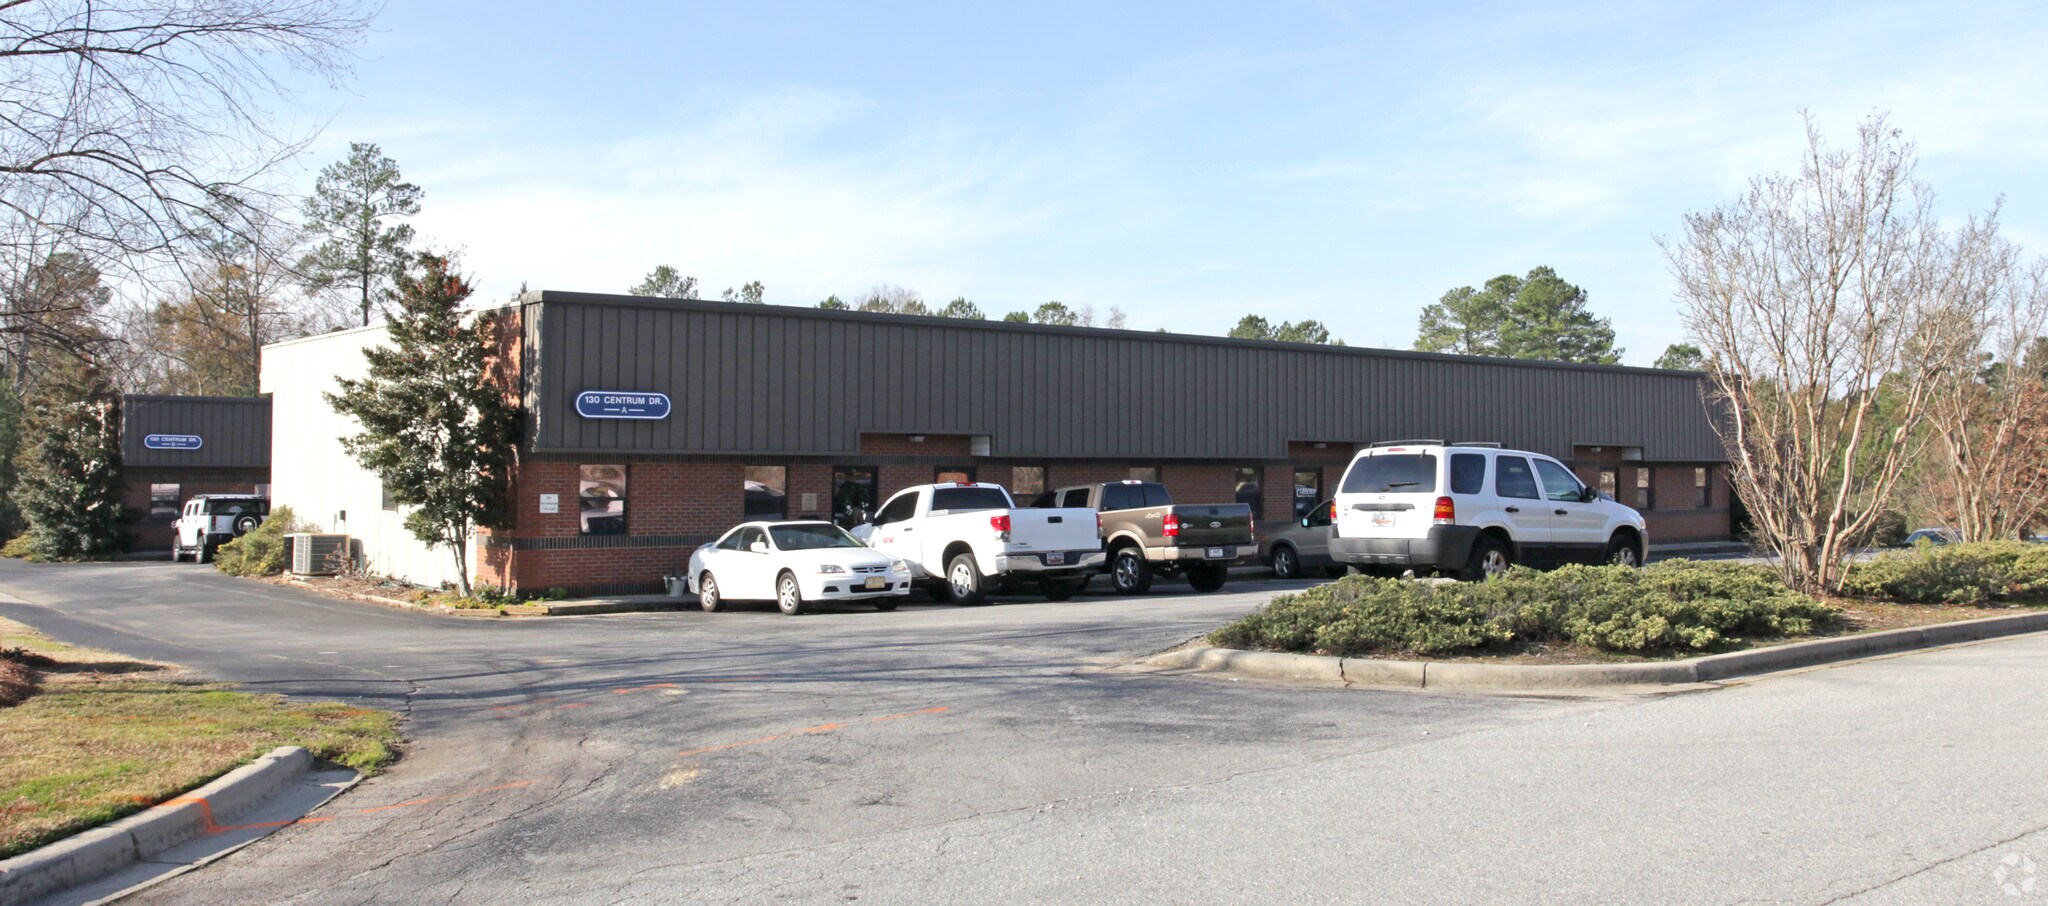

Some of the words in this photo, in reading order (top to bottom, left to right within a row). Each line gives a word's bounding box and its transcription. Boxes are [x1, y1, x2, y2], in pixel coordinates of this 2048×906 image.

[585, 396, 600, 404] 130
[604, 396, 645, 405] CENTRUM
[649, 397, 663, 405] DR.
